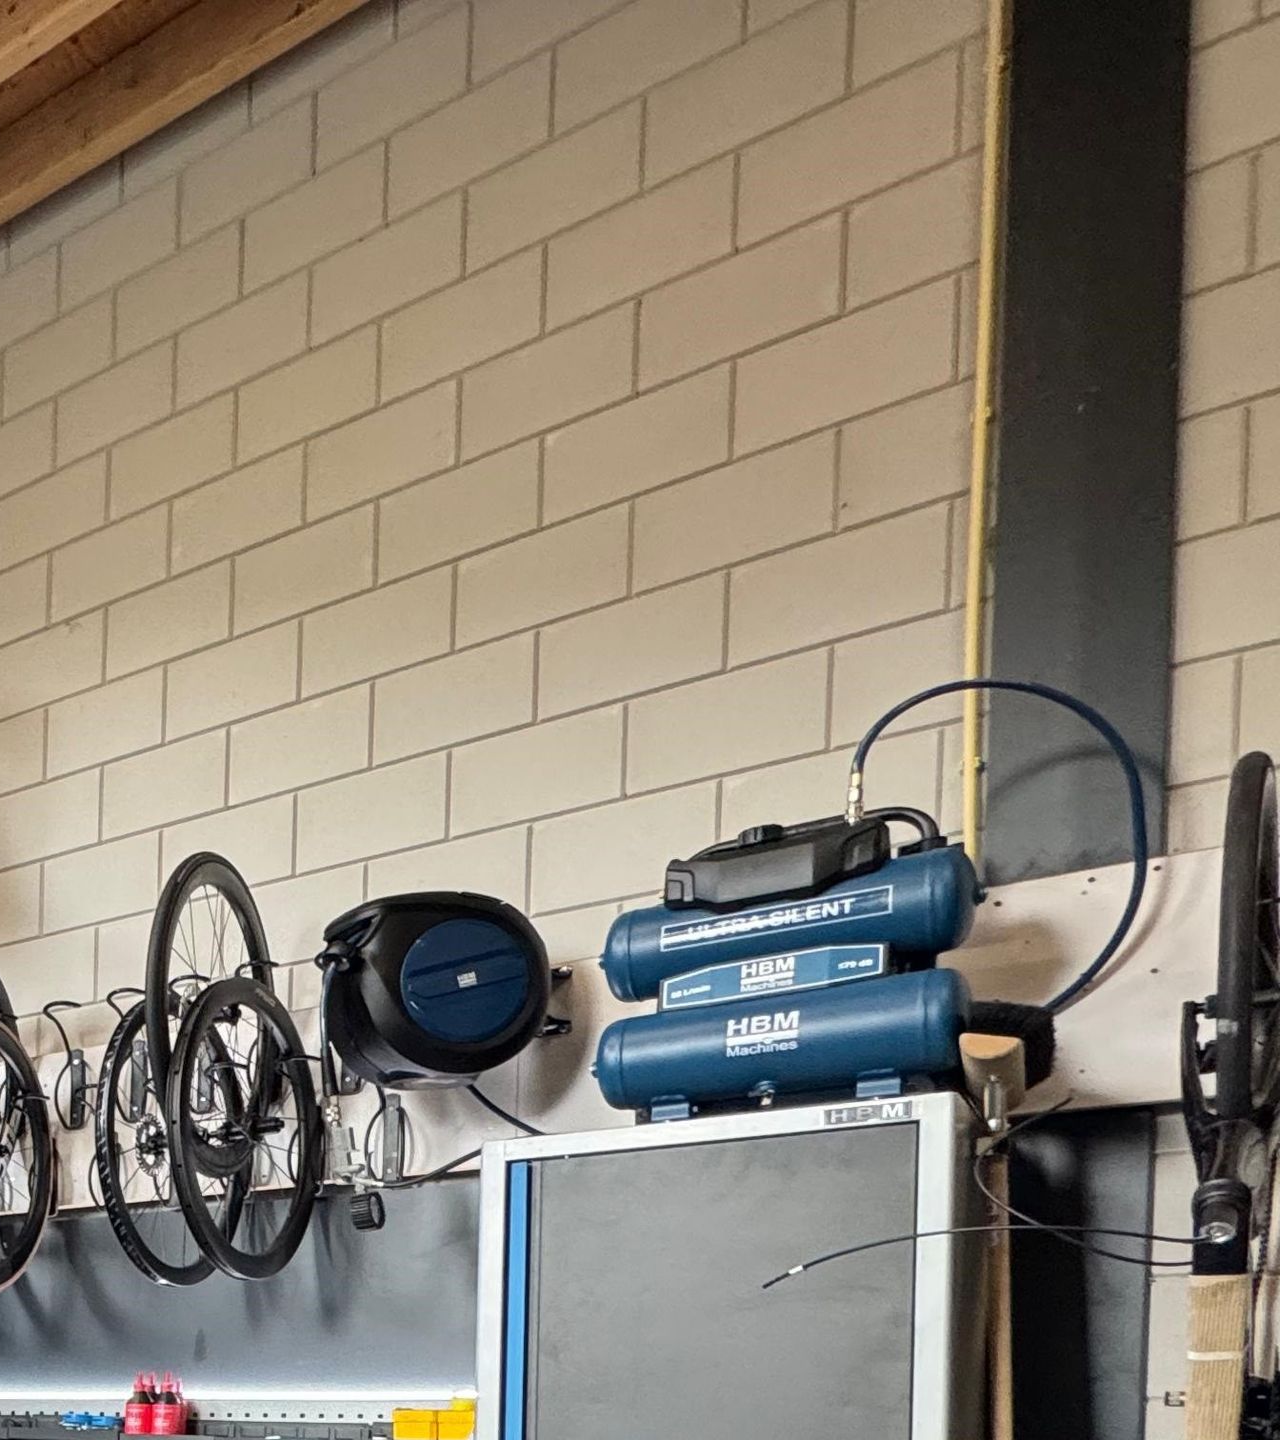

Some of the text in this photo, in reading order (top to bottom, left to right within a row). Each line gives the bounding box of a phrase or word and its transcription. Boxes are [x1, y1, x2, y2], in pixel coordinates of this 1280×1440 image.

[768, 897, 856, 928] SILENT
[740, 956, 796, 979] HBM
[740, 977, 794, 993] Machines
[726, 1009, 801, 1036] HBM
[726, 1039, 799, 1058] Machines
[830, 1102, 905, 1124] HBM
